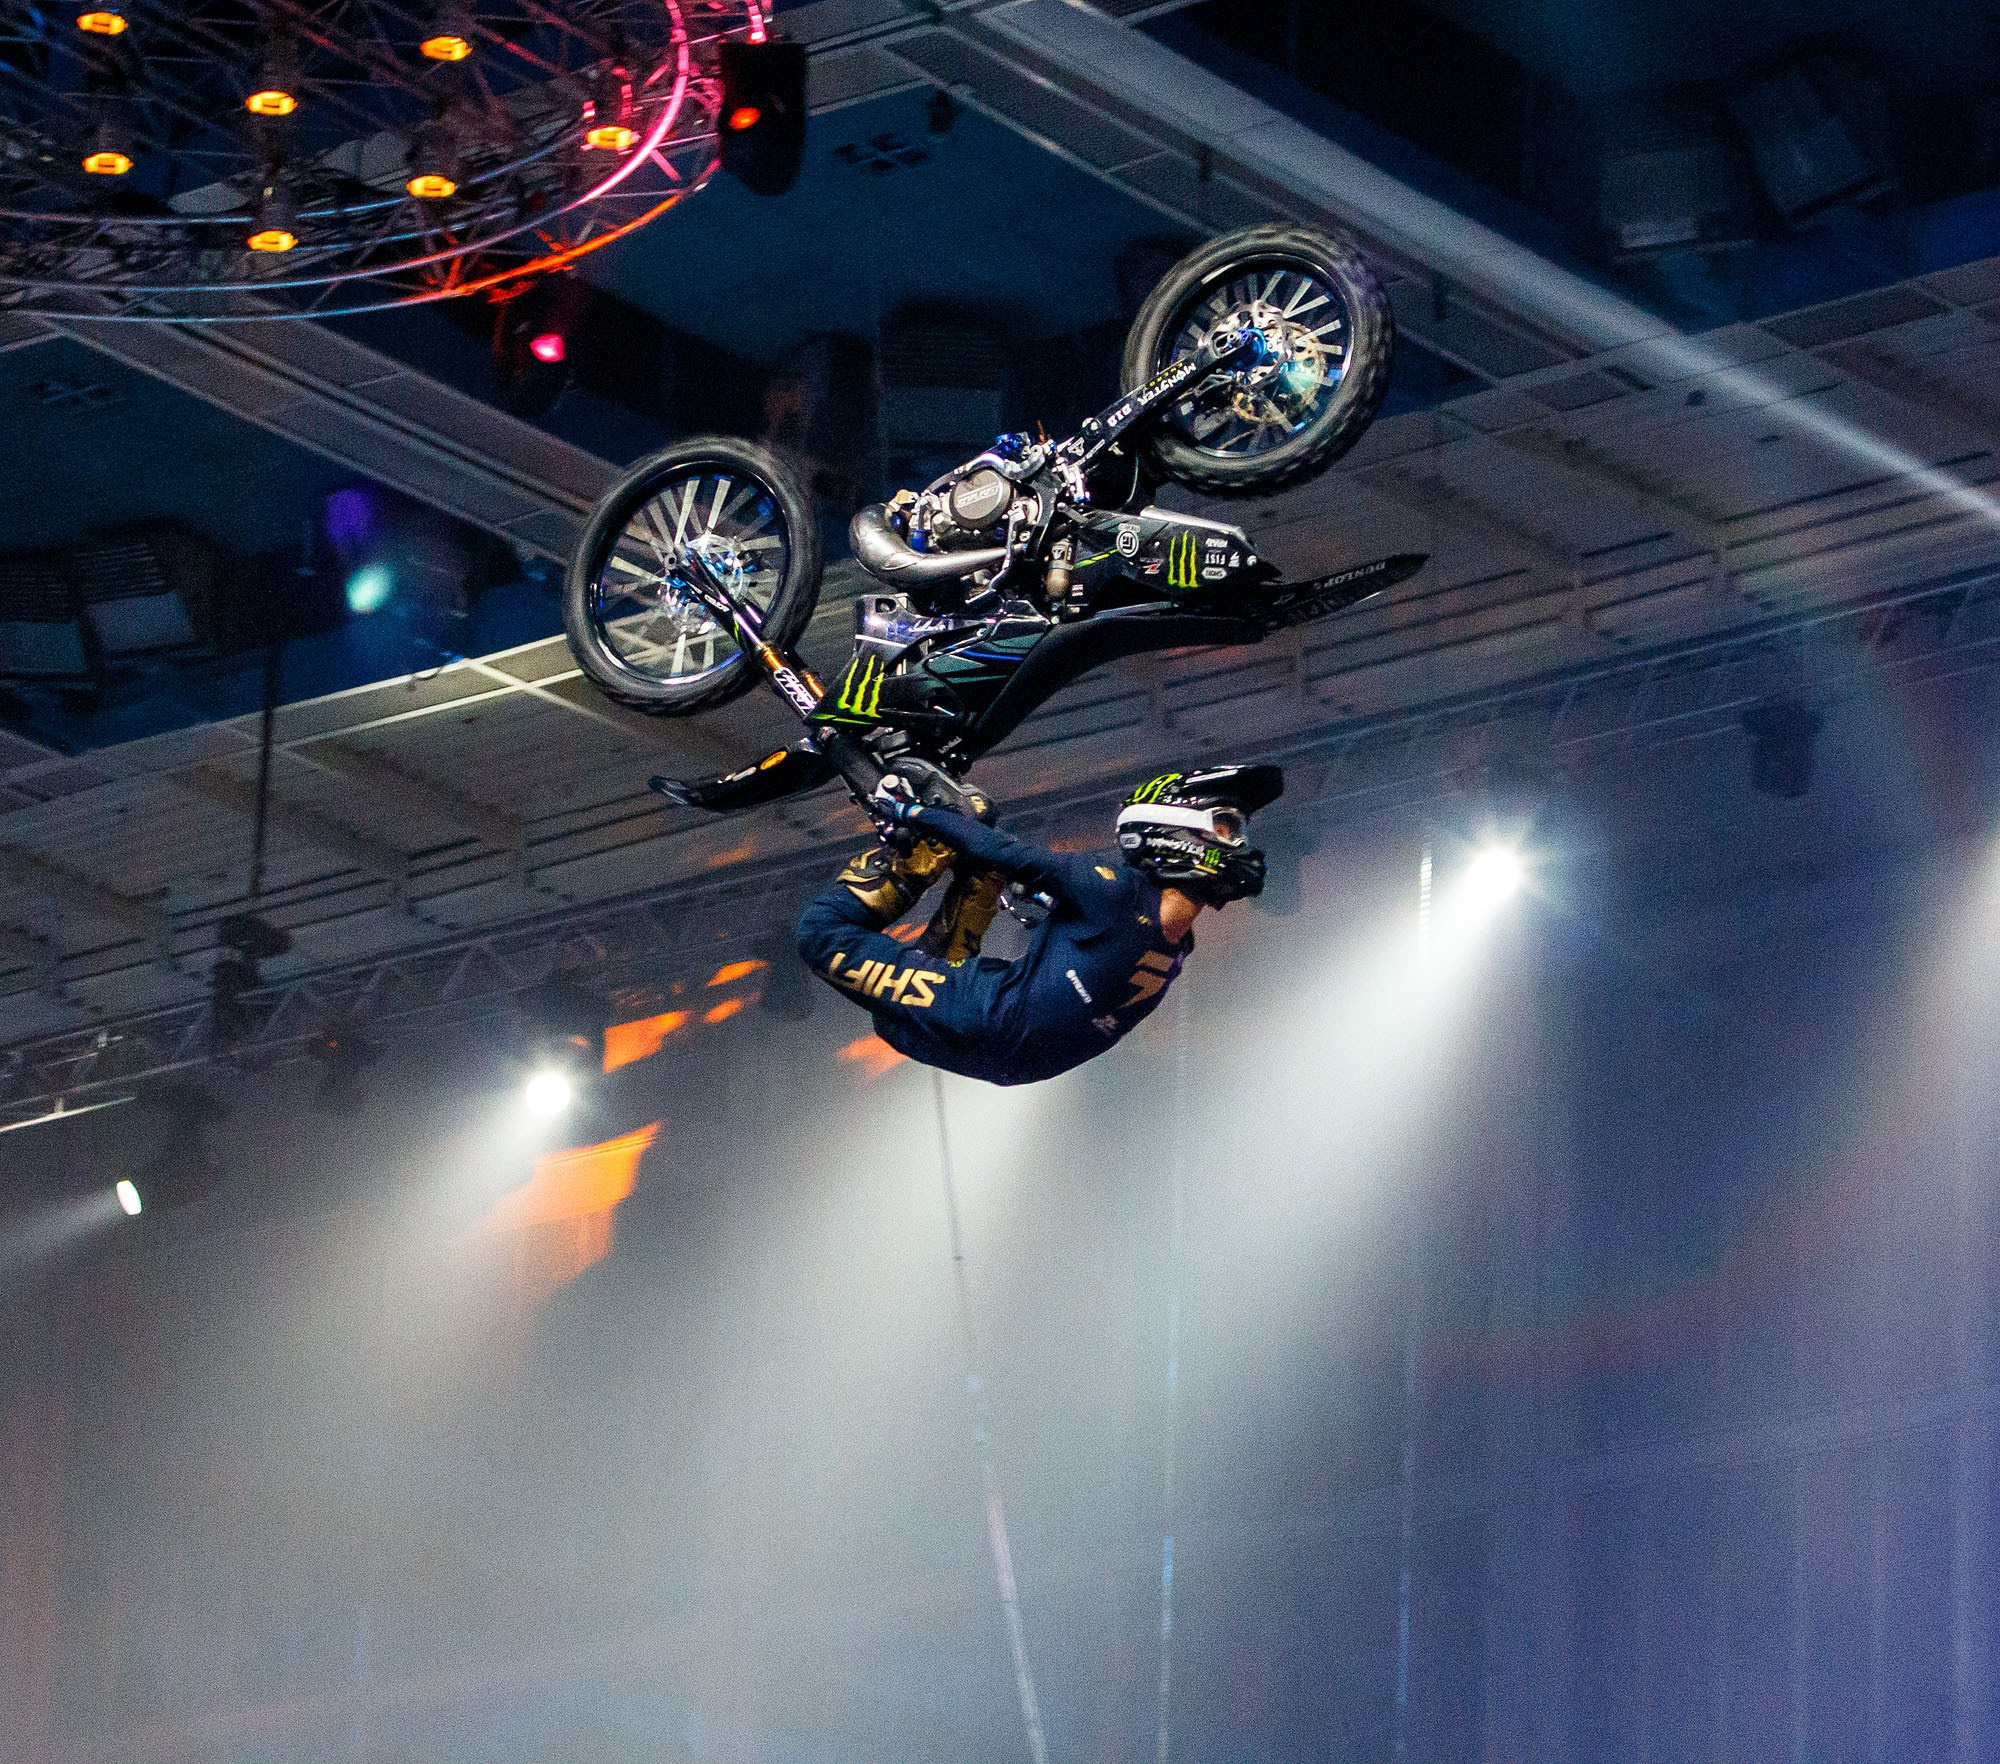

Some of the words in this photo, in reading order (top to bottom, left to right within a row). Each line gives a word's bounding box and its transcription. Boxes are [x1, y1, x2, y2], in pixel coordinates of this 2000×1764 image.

[1136, 362, 1197, 406] MONSTER
[1204, 553, 1226, 565] FIST
[1323, 560, 1387, 588] DUNLOP
[825, 952, 947, 1008] SHIFT
